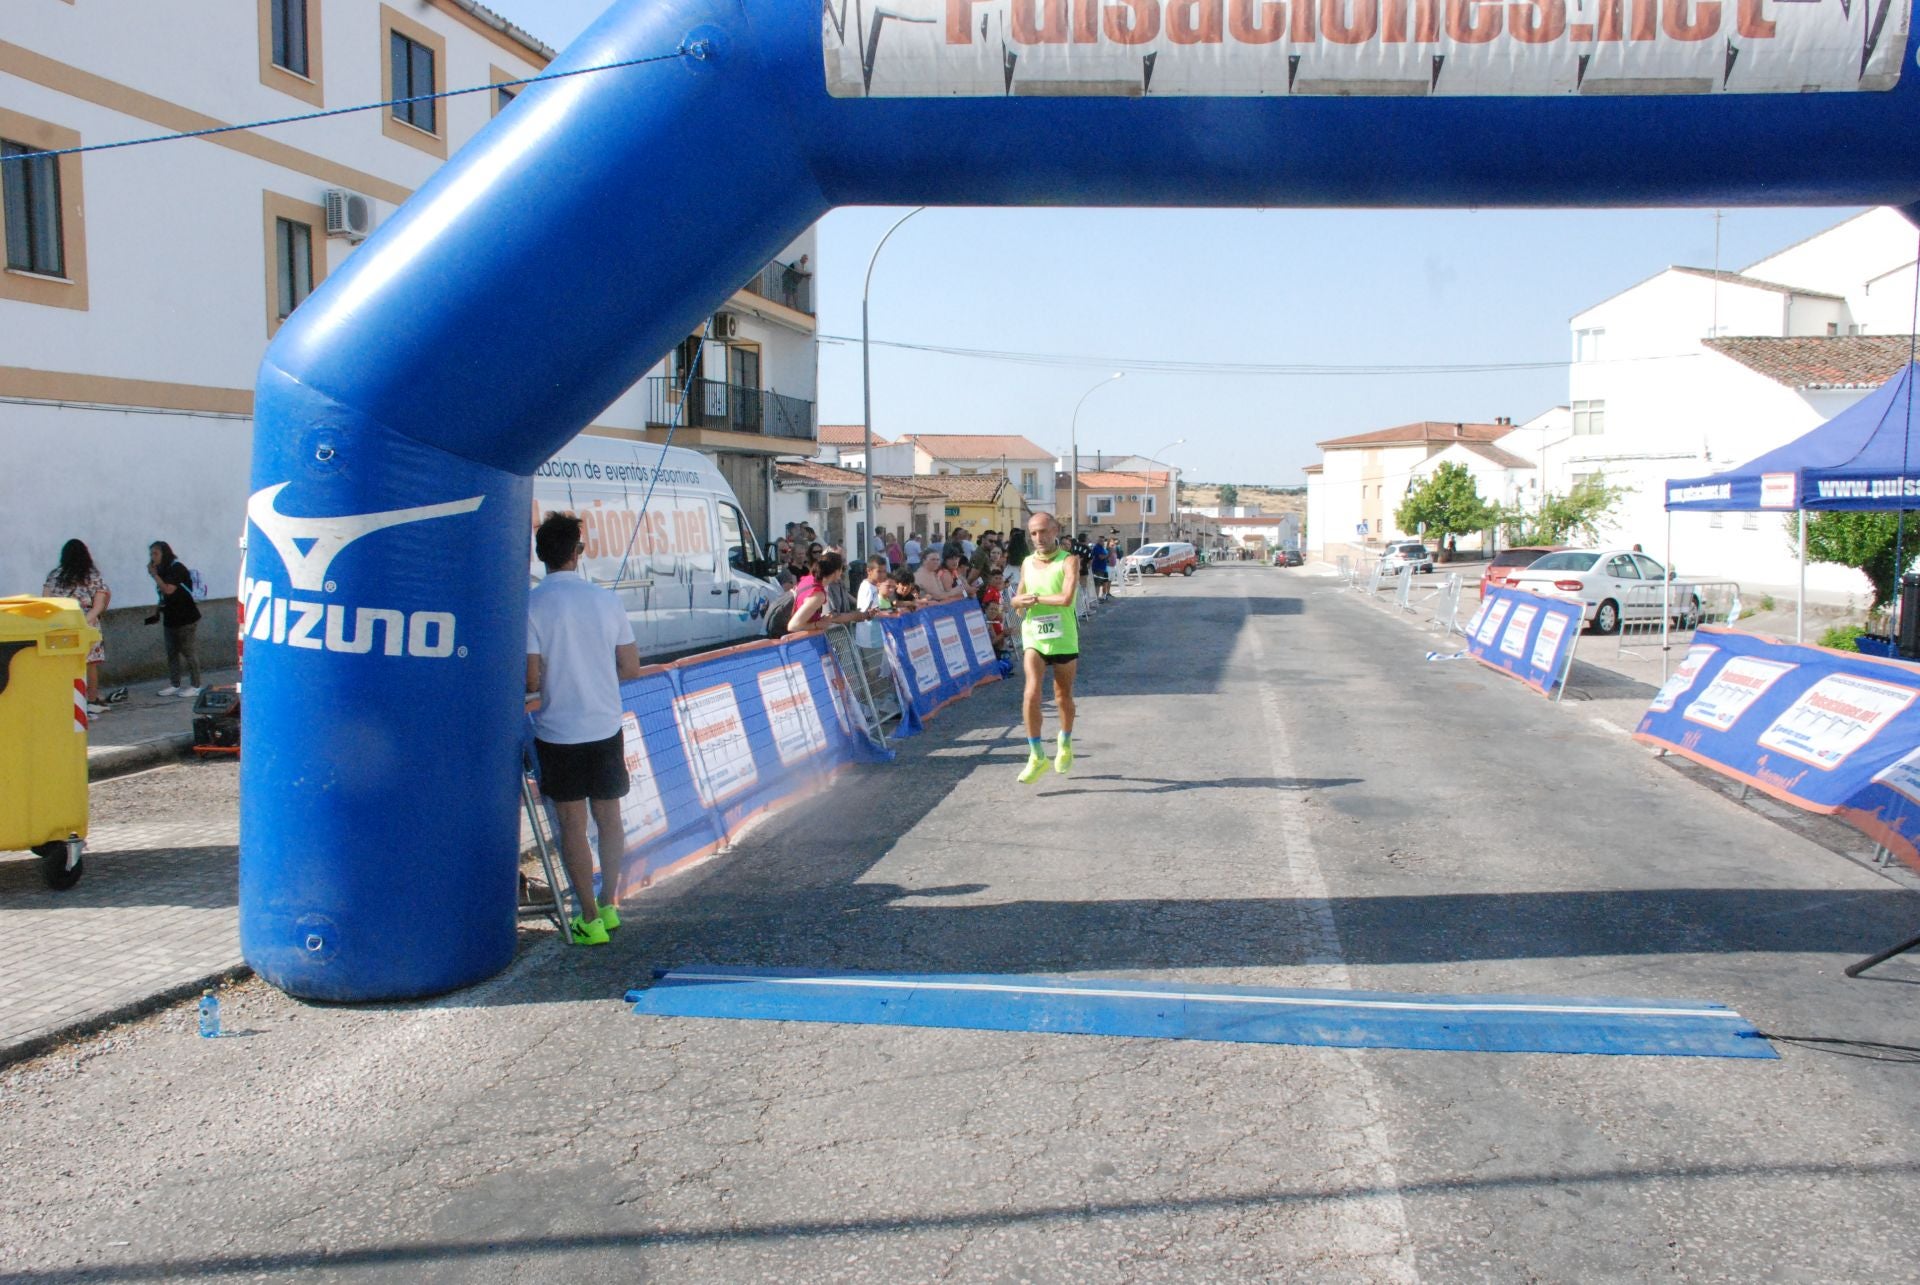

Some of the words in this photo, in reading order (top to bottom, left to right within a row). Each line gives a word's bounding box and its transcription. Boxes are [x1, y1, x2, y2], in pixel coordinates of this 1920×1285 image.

[584, 459, 602, 480] de
[605, 463, 648, 481] eventos
[650, 464, 700, 486] deportivos
[1037, 622, 1055, 635] 202
